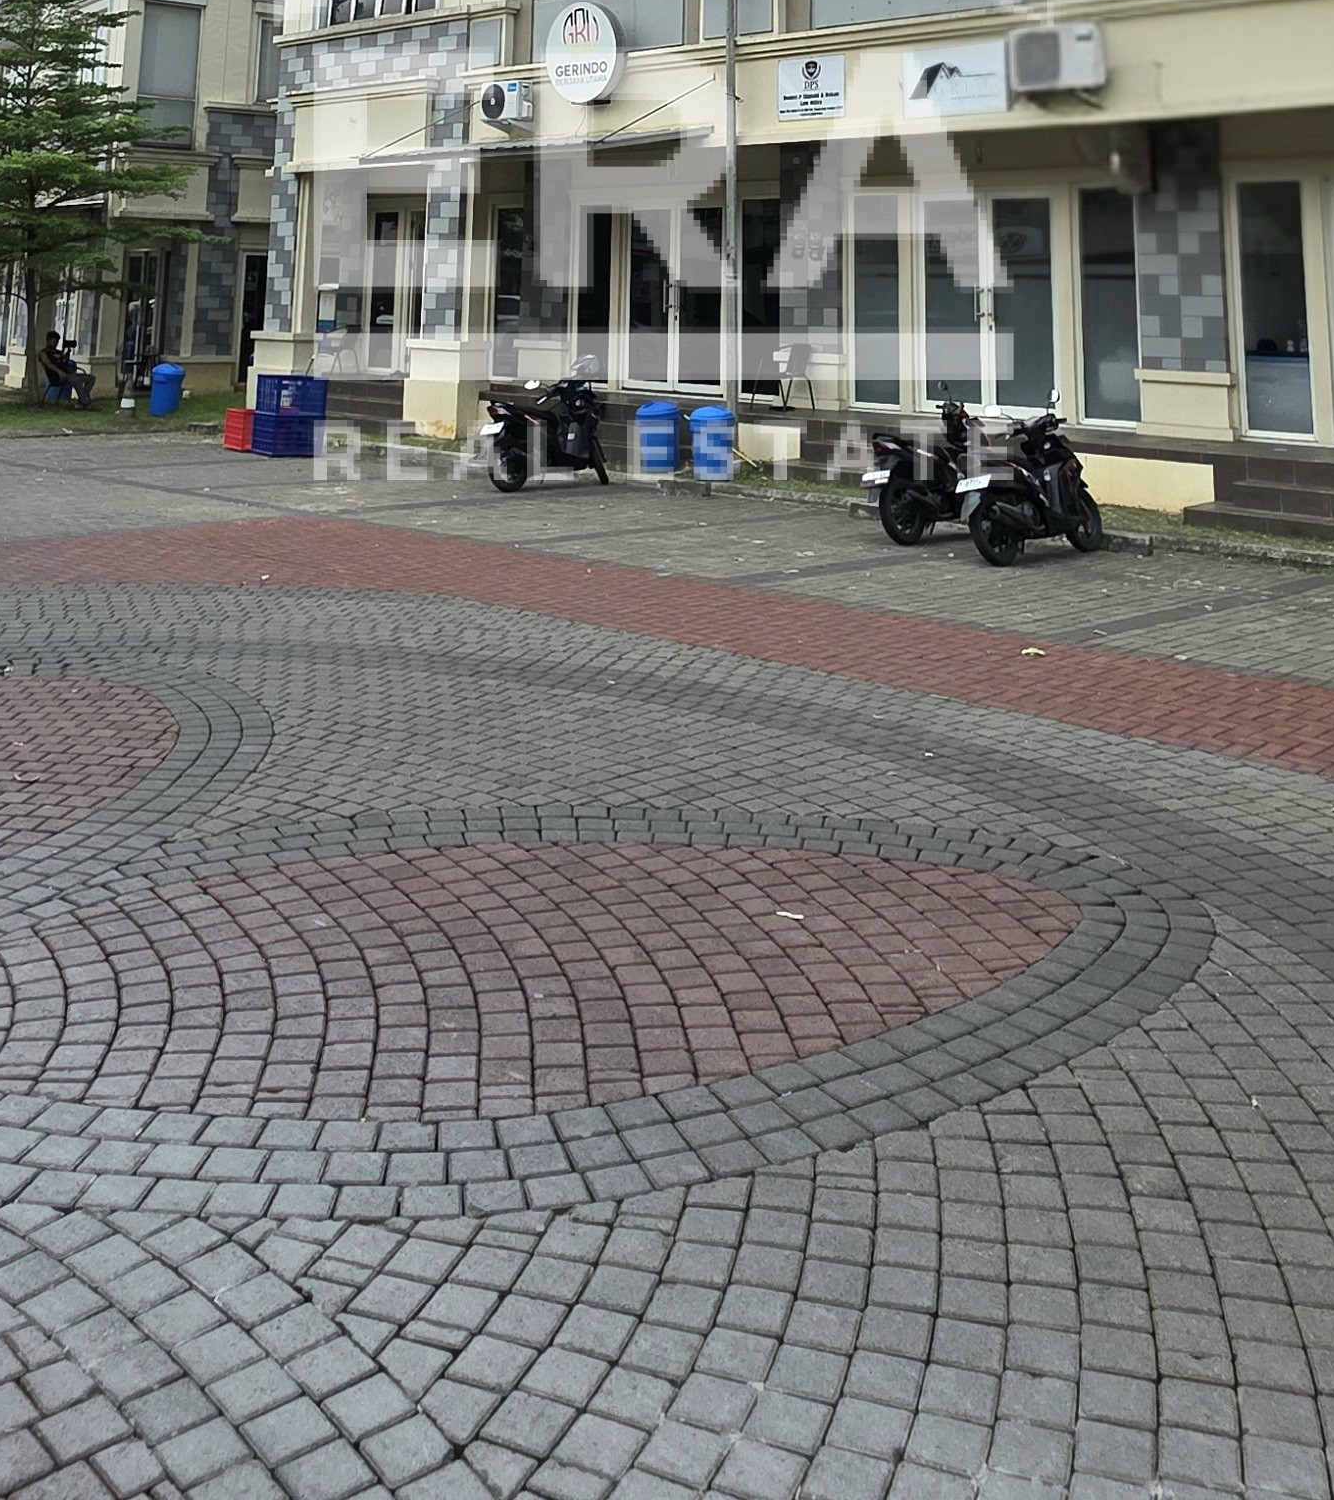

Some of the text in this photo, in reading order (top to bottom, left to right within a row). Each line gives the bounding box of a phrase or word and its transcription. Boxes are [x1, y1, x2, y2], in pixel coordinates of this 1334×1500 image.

[555, 61, 608, 77] GERINDO
[586, 75, 608, 84] UTAMA
[803, 80, 819, 90] DPS
